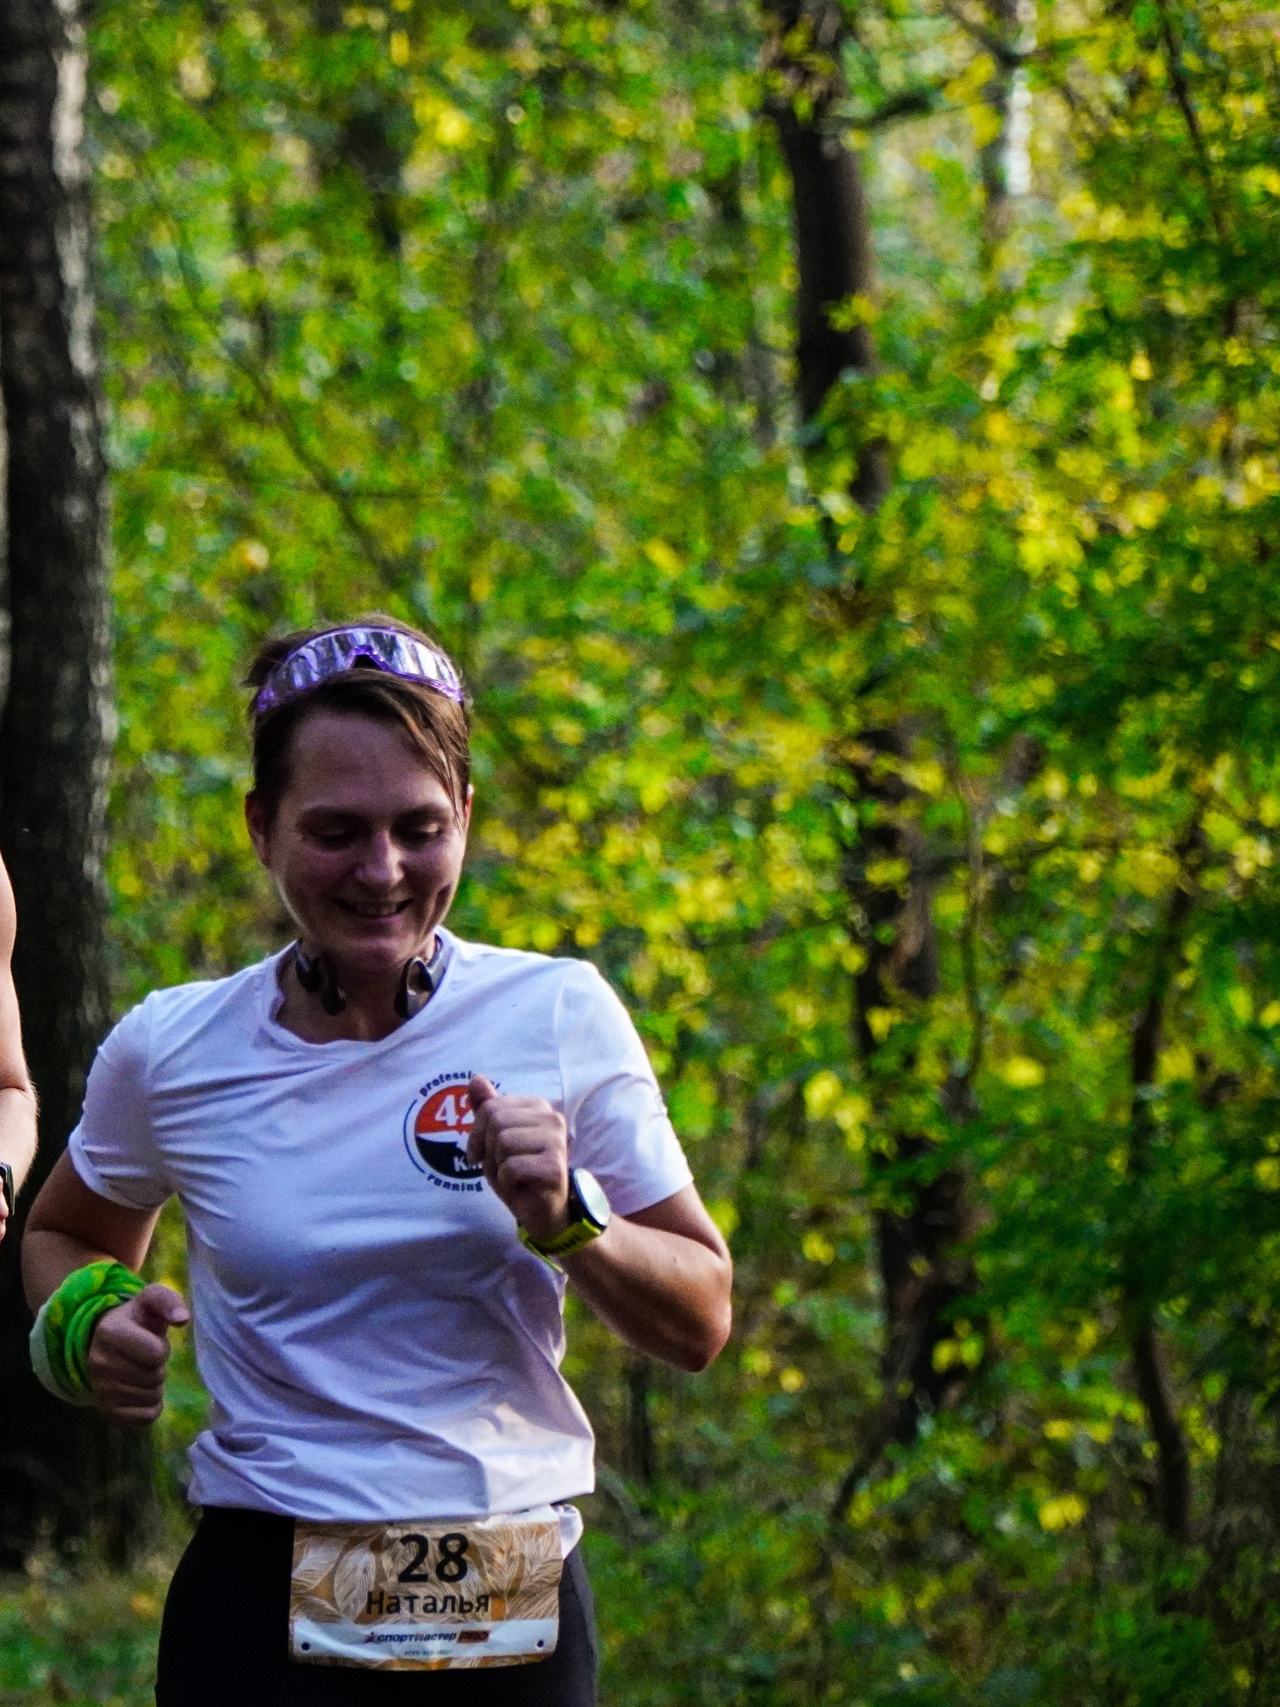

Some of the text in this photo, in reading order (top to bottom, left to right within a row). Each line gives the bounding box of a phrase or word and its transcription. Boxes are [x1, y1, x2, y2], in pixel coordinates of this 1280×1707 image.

[419, 1071, 500, 1097] professil
[427, 1174, 483, 1192] running
[397, 1532, 469, 1583] 28
[366, 1591, 490, 1615] Наталья
